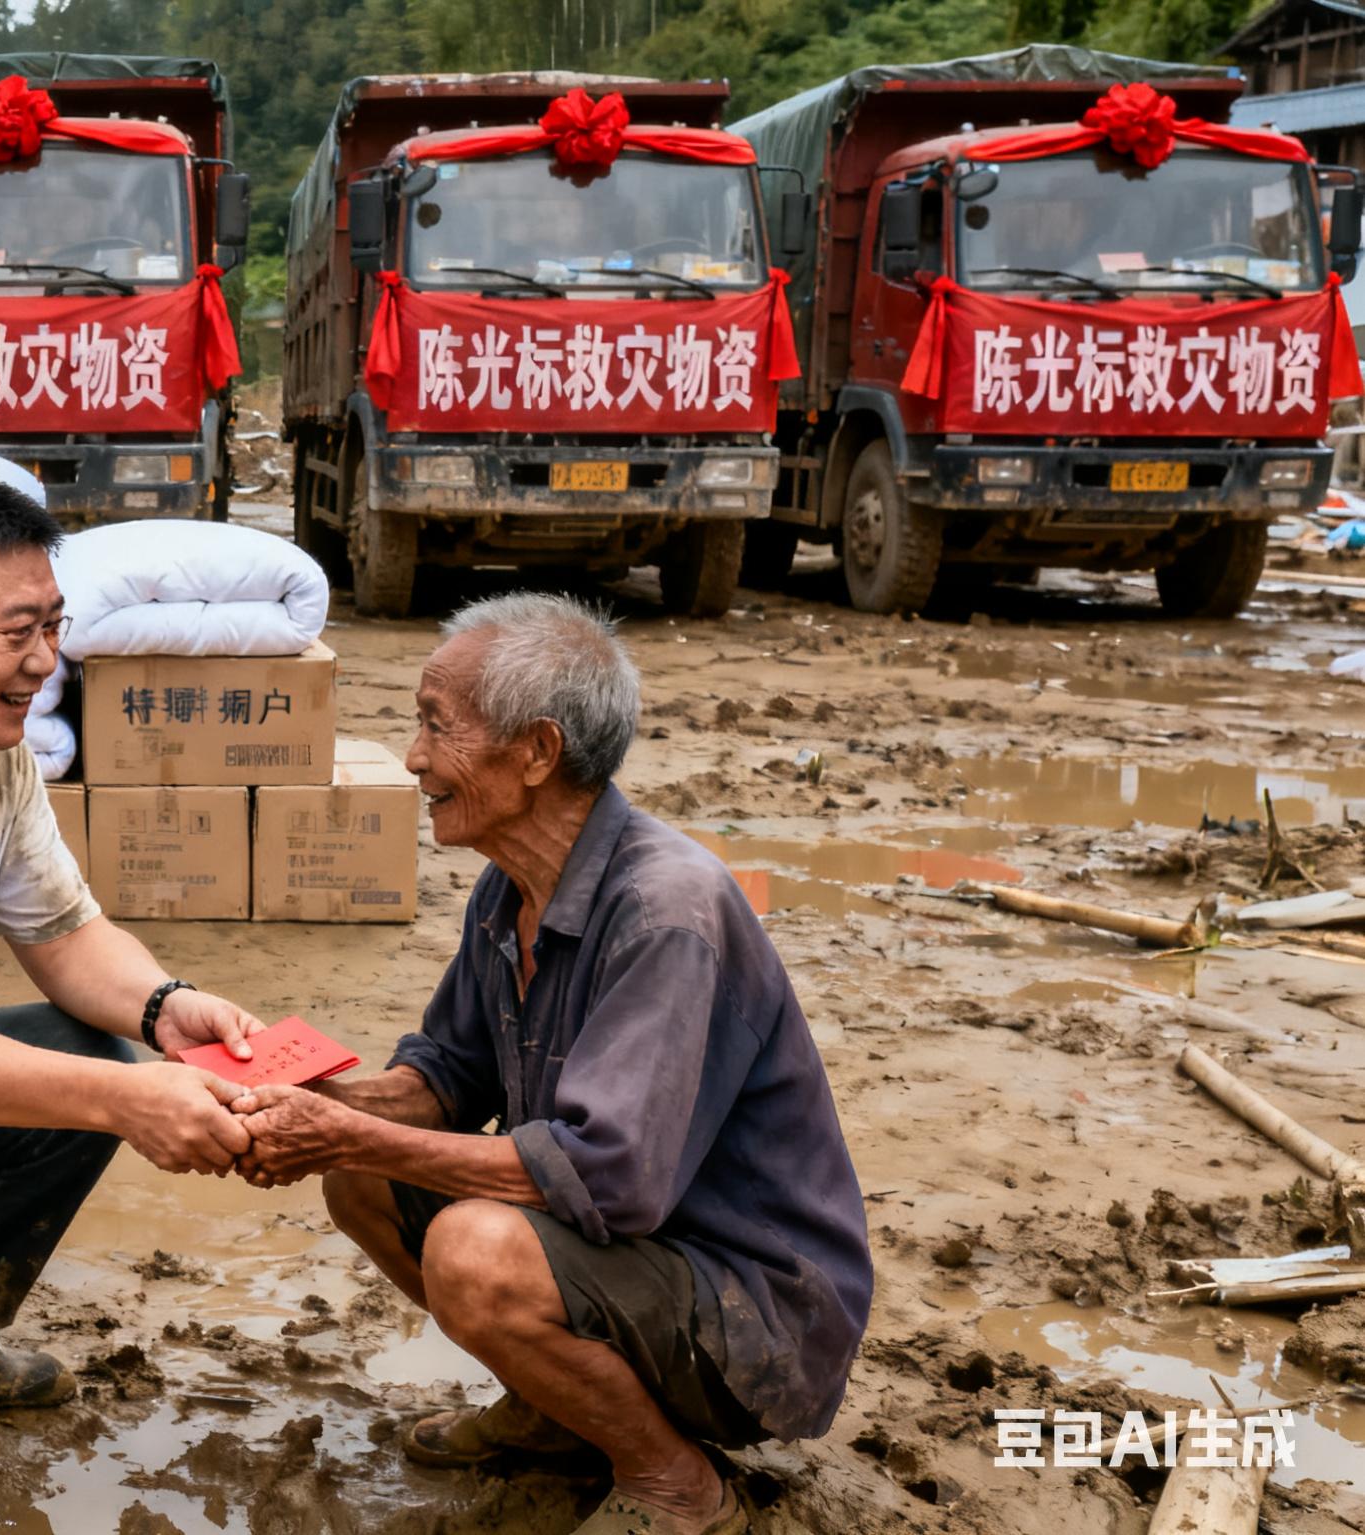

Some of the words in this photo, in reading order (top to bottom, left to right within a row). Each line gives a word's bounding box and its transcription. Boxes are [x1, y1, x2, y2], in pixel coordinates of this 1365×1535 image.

[419, 324, 756, 411] 陈光标救灾物资
[974, 325, 1320, 414] 陈光标救灾物资
